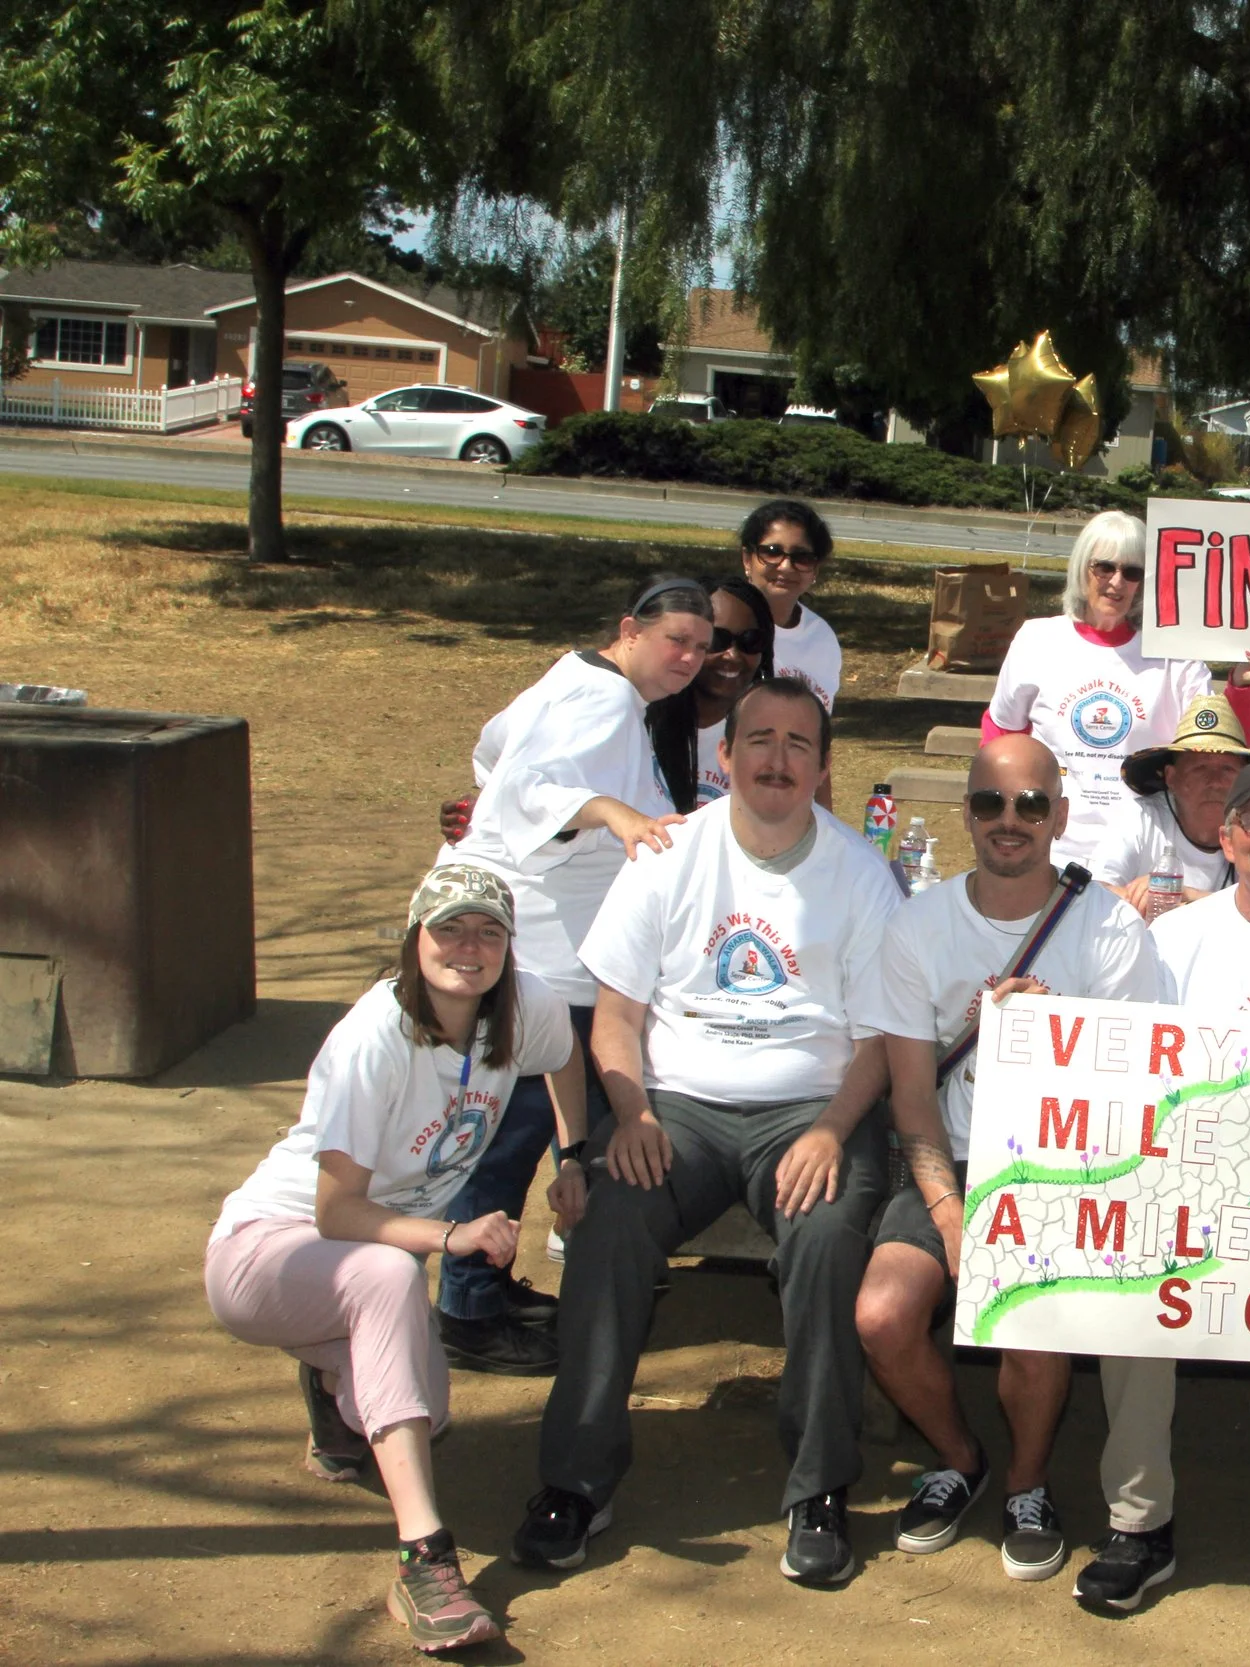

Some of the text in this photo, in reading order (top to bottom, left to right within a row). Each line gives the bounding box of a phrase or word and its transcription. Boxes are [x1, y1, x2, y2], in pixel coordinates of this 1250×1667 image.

[1057, 679, 1146, 721] 2025 Walk This Way
[705, 770, 730, 789] This
[703, 923, 727, 957] 2025
[756, 917, 782, 946] This
[780, 943, 802, 977] Way
[997, 1008, 1242, 1083] EVERY
[410, 1120, 442, 1155] 2025
[1038, 1097, 1220, 1165] MILE
[985, 1193, 1027, 1246] A
